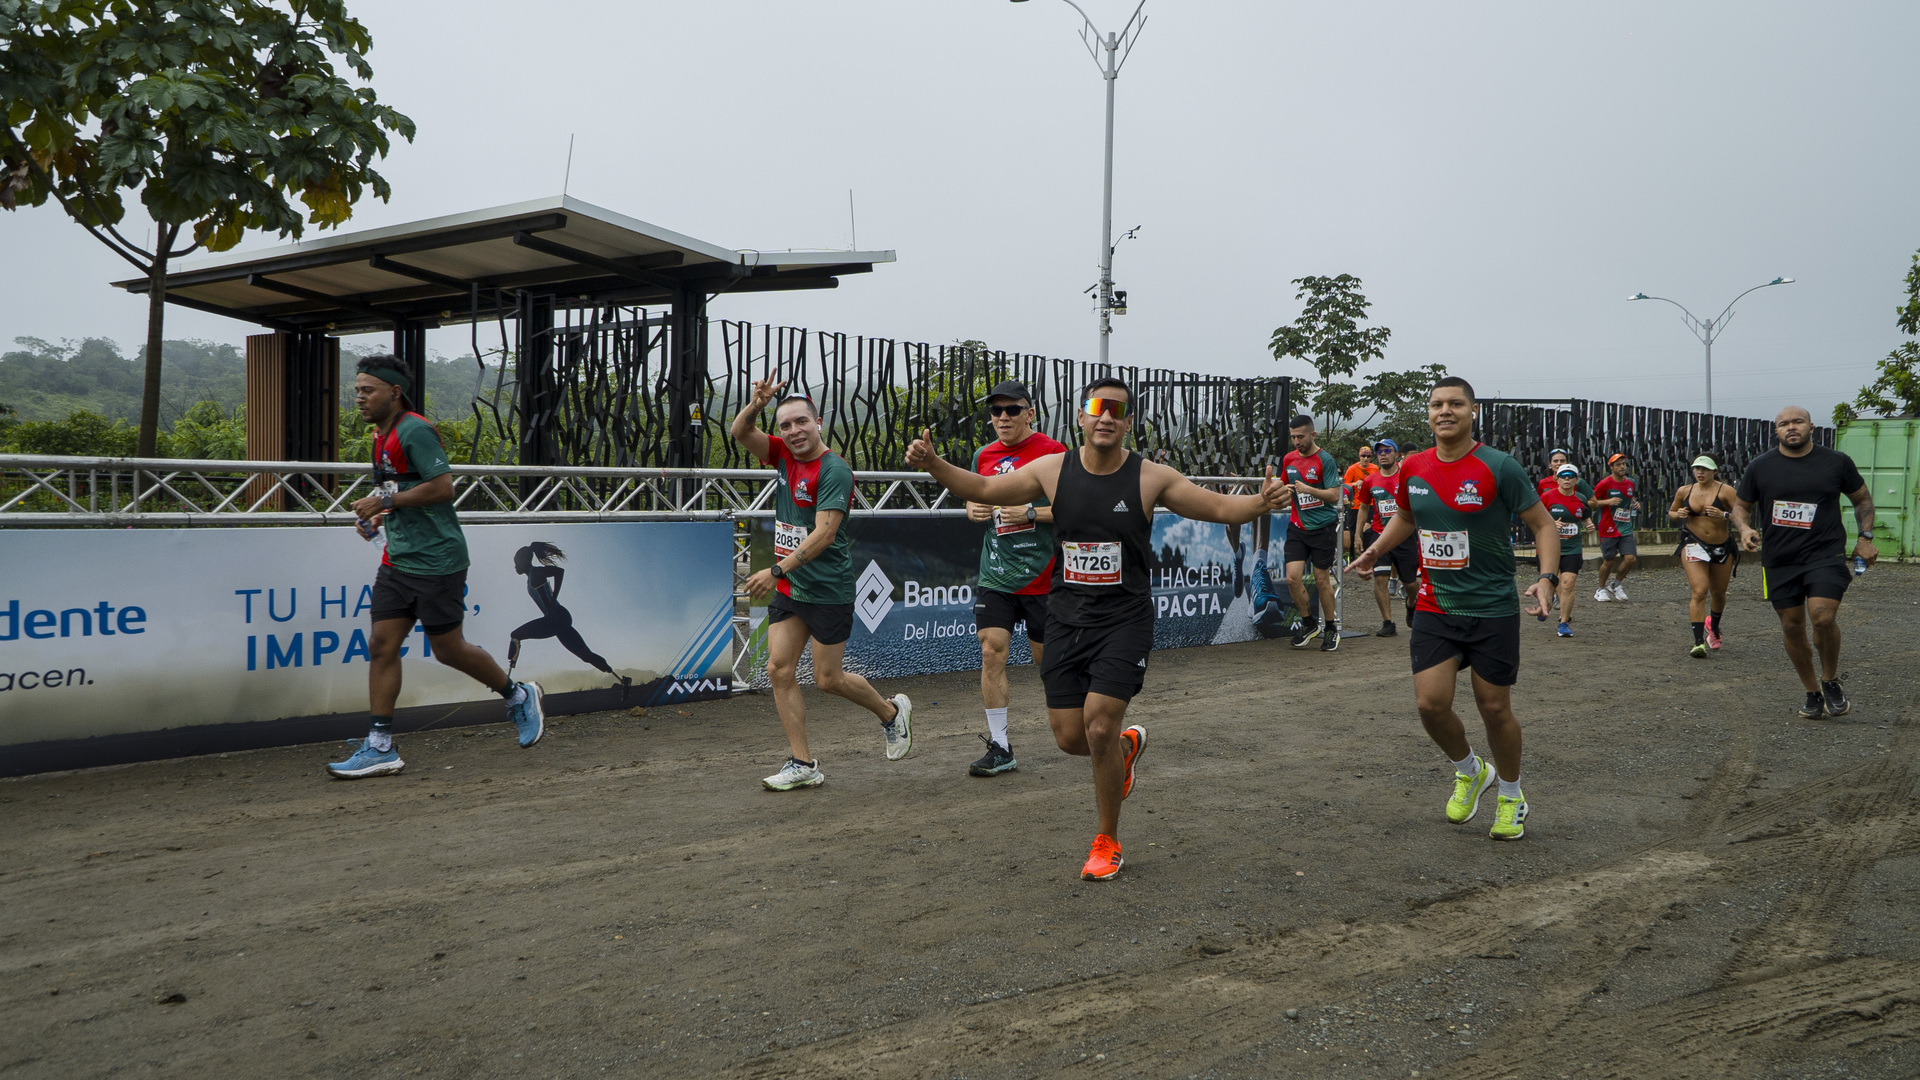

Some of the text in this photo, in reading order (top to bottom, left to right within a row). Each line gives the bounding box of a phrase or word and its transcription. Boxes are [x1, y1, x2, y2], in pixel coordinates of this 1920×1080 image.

[1781, 509, 1803, 520] 501
[775, 532, 801, 549] 2083
[1428, 543, 1454, 557] 450
[1072, 555, 1111, 571] 1726
[1160, 565, 1227, 590] HACER,
[904, 580, 972, 608] Banco
[235, 587, 297, 624] TU
[904, 621, 930, 640] Del
[932, 619, 966, 638] lado
[666, 678, 728, 695] AVAL
